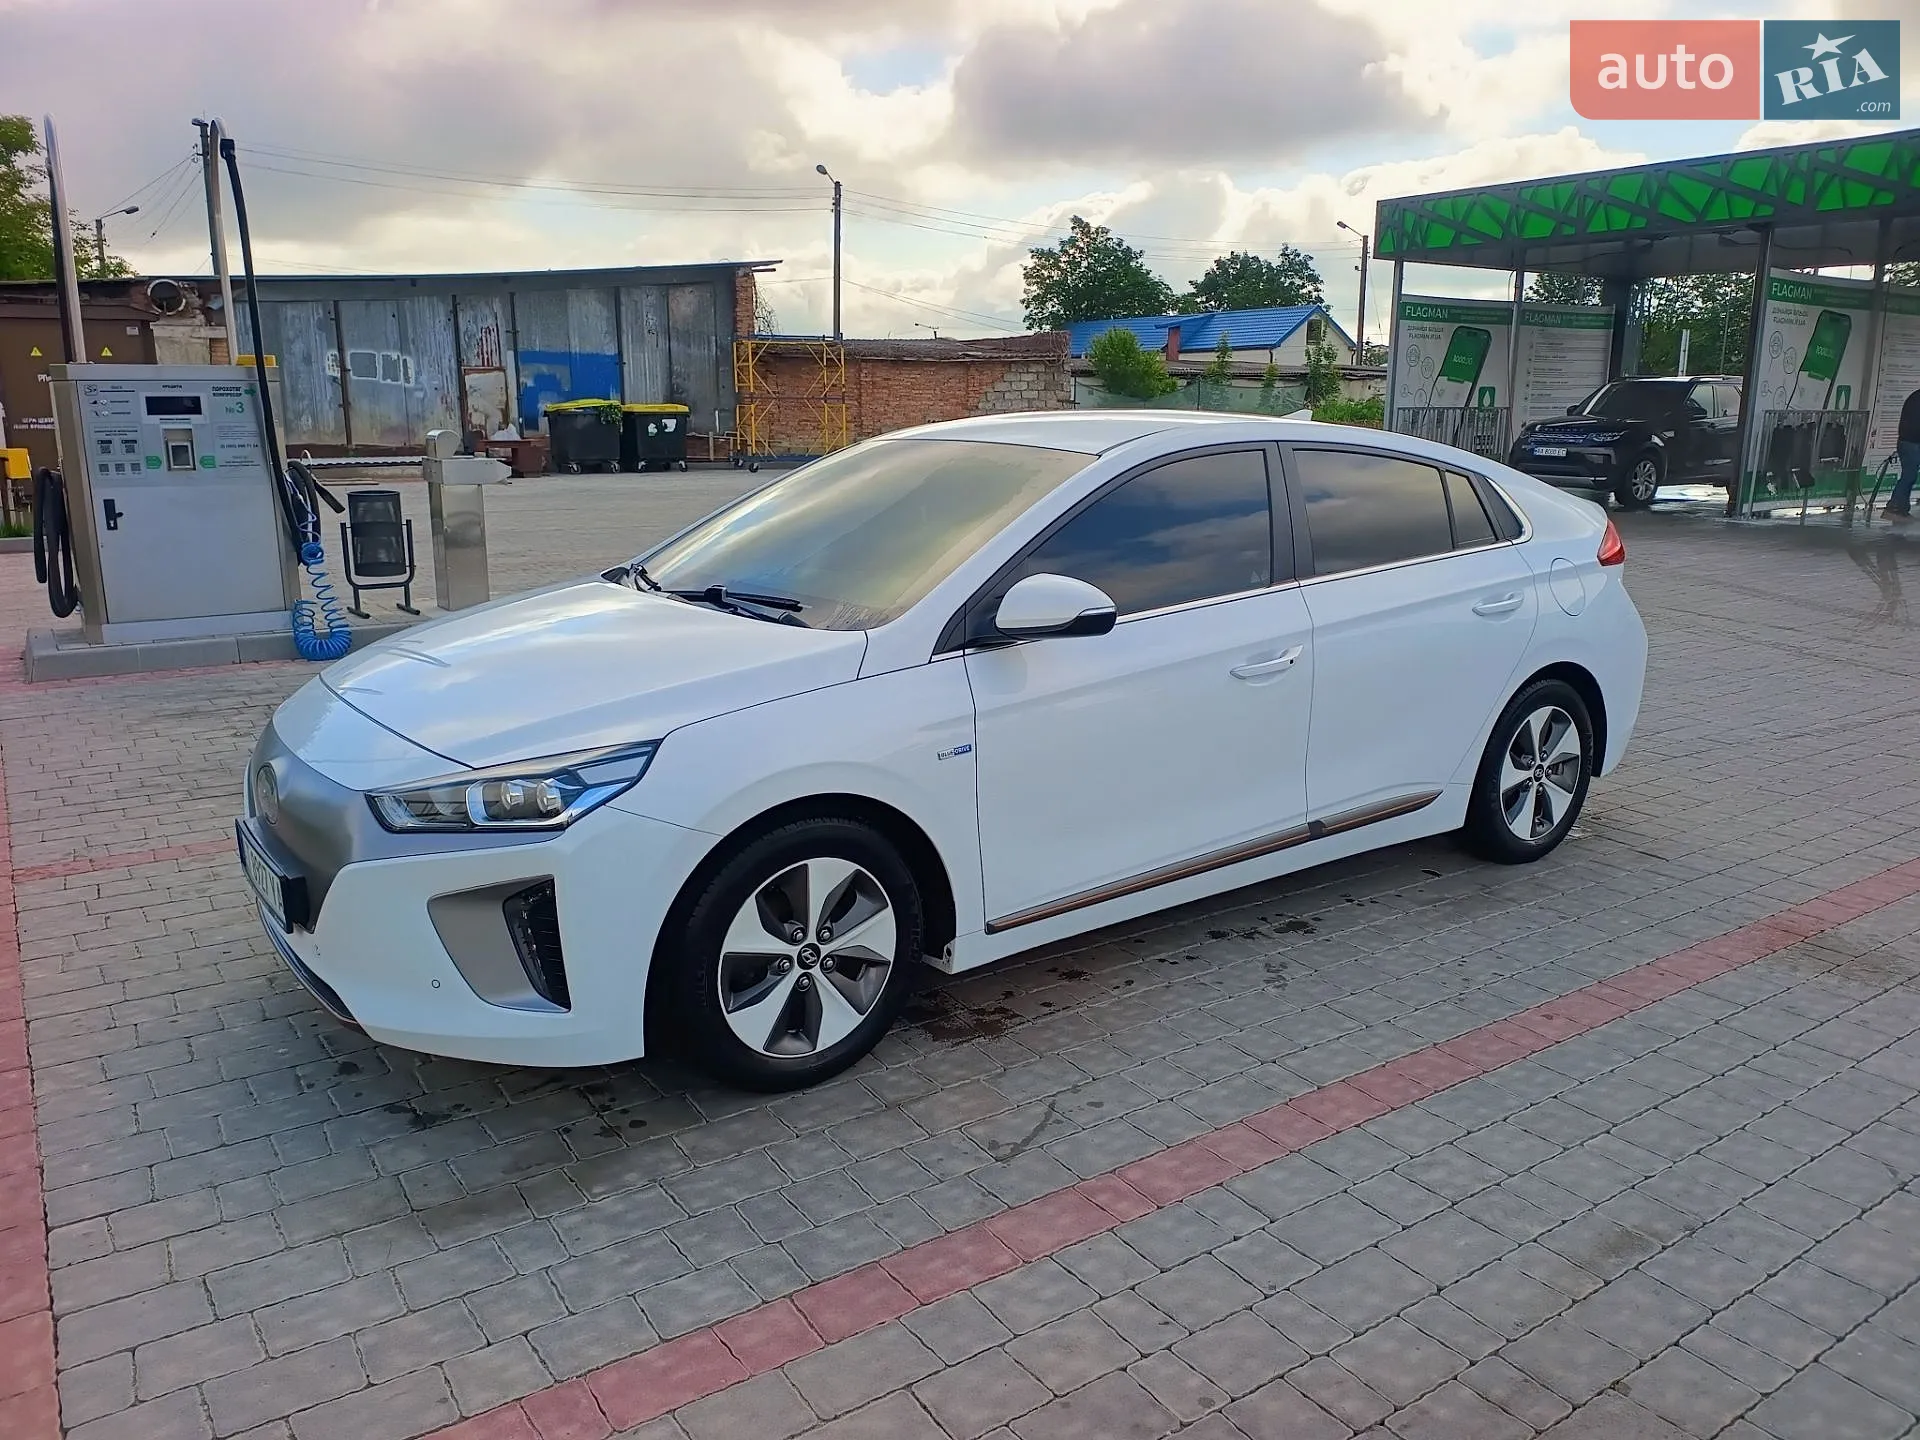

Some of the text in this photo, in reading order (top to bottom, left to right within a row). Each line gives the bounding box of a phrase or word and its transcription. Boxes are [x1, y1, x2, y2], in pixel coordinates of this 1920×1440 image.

[1771, 282, 1812, 300] FLAGMAN
[1405, 305, 1448, 319] FLAGMAN
[1524, 311, 1561, 325] FLAGMAN
[235, 401, 245, 414] 3
